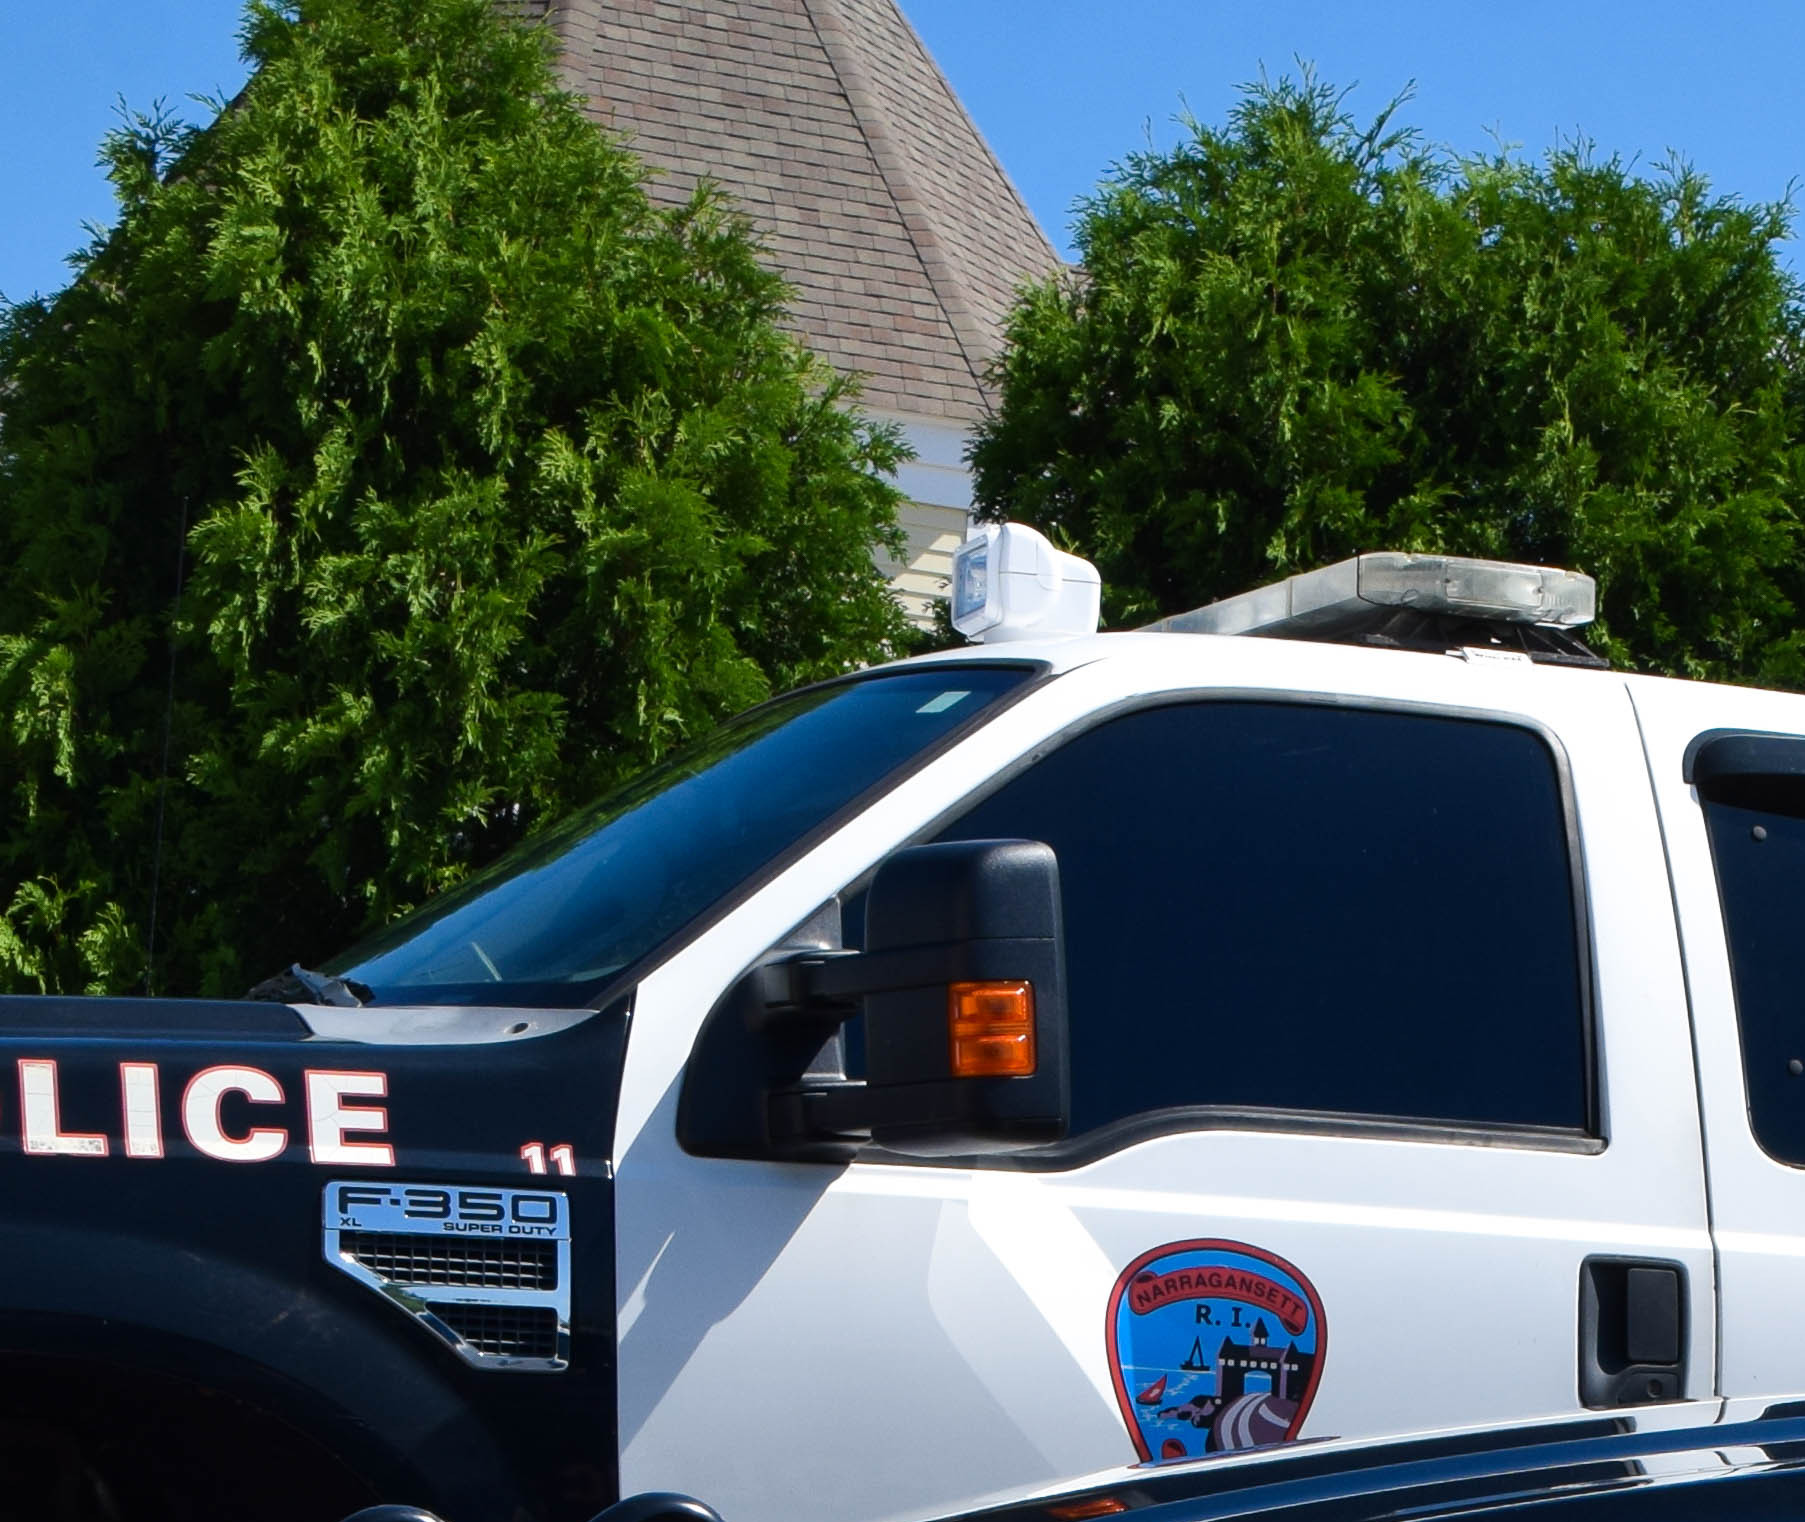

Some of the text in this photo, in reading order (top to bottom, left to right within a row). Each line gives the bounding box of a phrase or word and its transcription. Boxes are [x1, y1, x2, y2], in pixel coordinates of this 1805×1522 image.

[520, 1141, 577, 1176] 11
[339, 1217, 362, 1228] XL
[443, 1222, 558, 1237] SUPER DUTY
[1136, 1273, 1303, 1318] NARRAGANSETT
